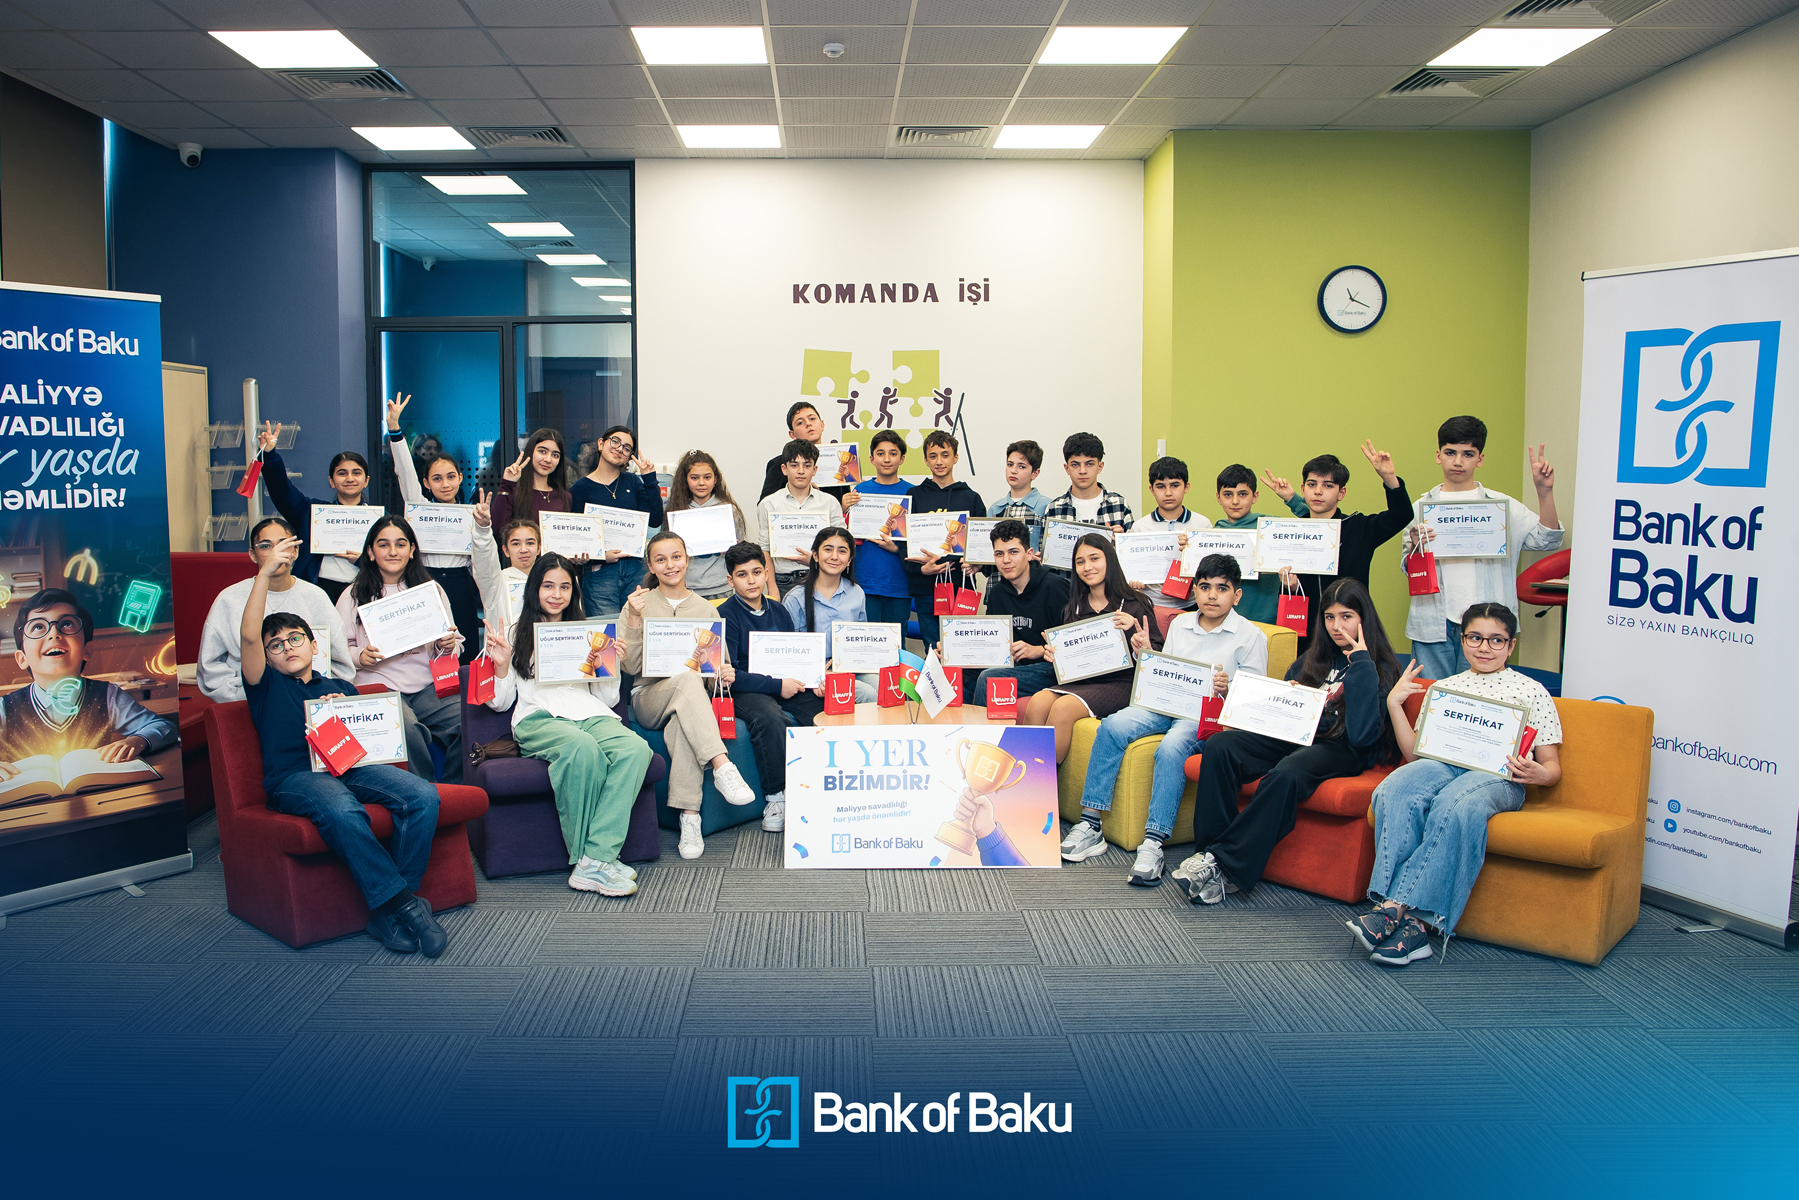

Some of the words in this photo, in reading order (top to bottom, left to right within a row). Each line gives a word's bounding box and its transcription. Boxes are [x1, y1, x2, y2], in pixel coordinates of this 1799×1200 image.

[792, 282, 940, 304] KOMANDA
[958, 277, 990, 306] İŞİ
[0, 325, 49, 351] ank
[50, 328, 74, 353] of
[78, 328, 140, 356] Baku
[21, 436, 140, 487] yaşda
[0, 482, 127, 511] ƏMLİDİR!
[325, 517, 370, 525] SERTİFİKAT
[419, 515, 463, 524] SERTİFİKAT
[552, 524, 591, 532] SERTİFİKAT
[1437, 514, 1492, 524] SERTİFİKAT
[1612, 498, 1719, 548] Bank
[1722, 505, 1764, 552] of
[1198, 541, 1246, 549] SERTİFİKAT
[1272, 532, 1323, 541] SERTİFİKAT
[1130, 544, 1174, 553] SERTİFİKAT
[1608, 548, 1759, 625] Baku
[378, 600, 427, 623] SERTİFİKAT
[845, 635, 888, 643] SERTİFİKAT
[954, 628, 999, 637] SERTİFİKAT
[1063, 630, 1109, 648] SERTİFİKAT
[1606, 614, 1636, 629] SİZƏ
[1639, 619, 1677, 635] YAXIN
[1681, 625, 1755, 646] BANKÇILIQ
[764, 646, 811, 655] SERTİFİKAT
[1152, 667, 1204, 686] SERTİFİKAT
[340, 712, 385, 725] RTİFİKAT
[1443, 709, 1505, 731] SERTİFİKAT
[824, 740, 840, 768] I
[855, 739, 930, 767] YER
[823, 769, 931, 791] BİZİMDİR!
[1685, 806, 1772, 835] instagram.com/bankofbaku
[854, 837, 882, 849] Bank
[882, 837, 894, 849] of
[895, 837, 924, 849] Baku
[1682, 827, 1762, 854] youtube.com/bankofbaku
